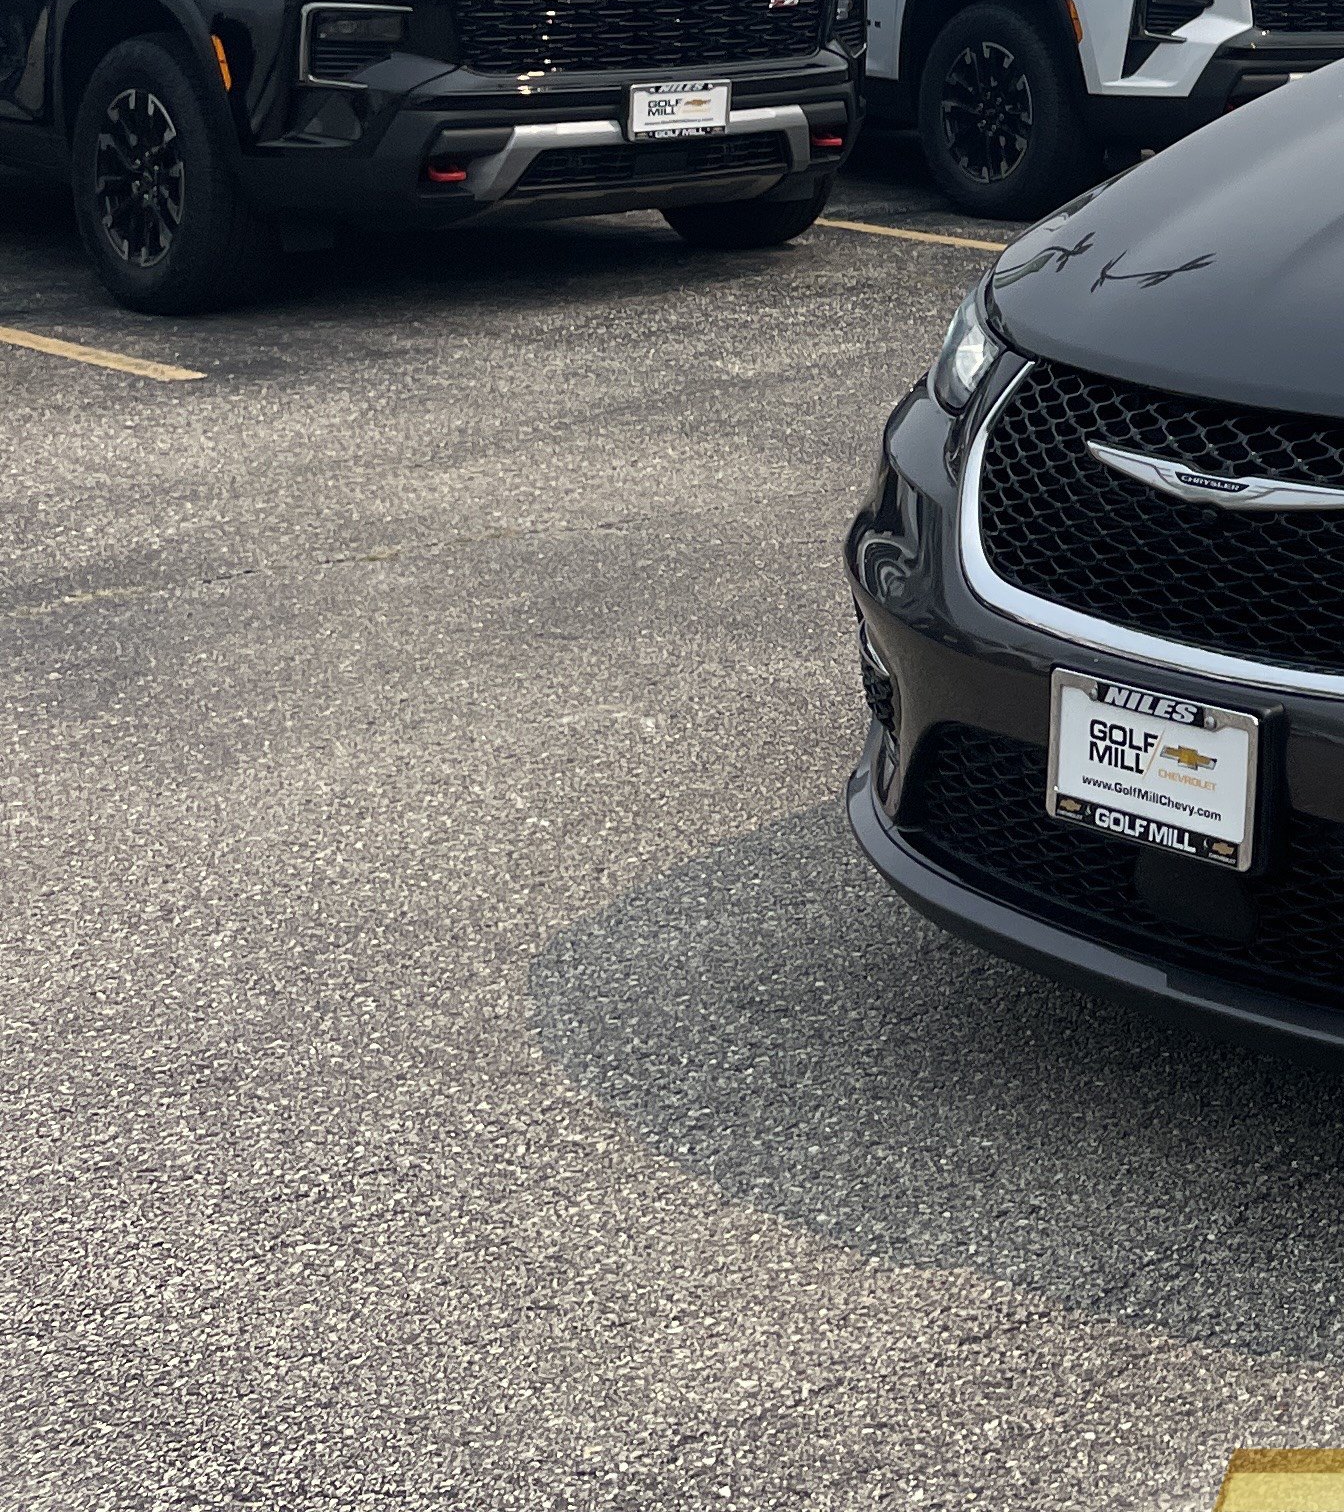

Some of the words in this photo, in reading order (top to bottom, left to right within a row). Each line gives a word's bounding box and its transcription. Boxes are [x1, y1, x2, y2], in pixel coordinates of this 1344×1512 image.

[1104, 686, 1198, 724] NILES
[1089, 718, 1159, 753] GOLF
[1088, 741, 1145, 775] MILL
[1158, 768, 1217, 791] CHEVROLET
[1081, 774, 1222, 822] www.GolfMillChevy.com
[1094, 807, 1148, 838] GOLF
[1148, 822, 1197, 853] MILL
